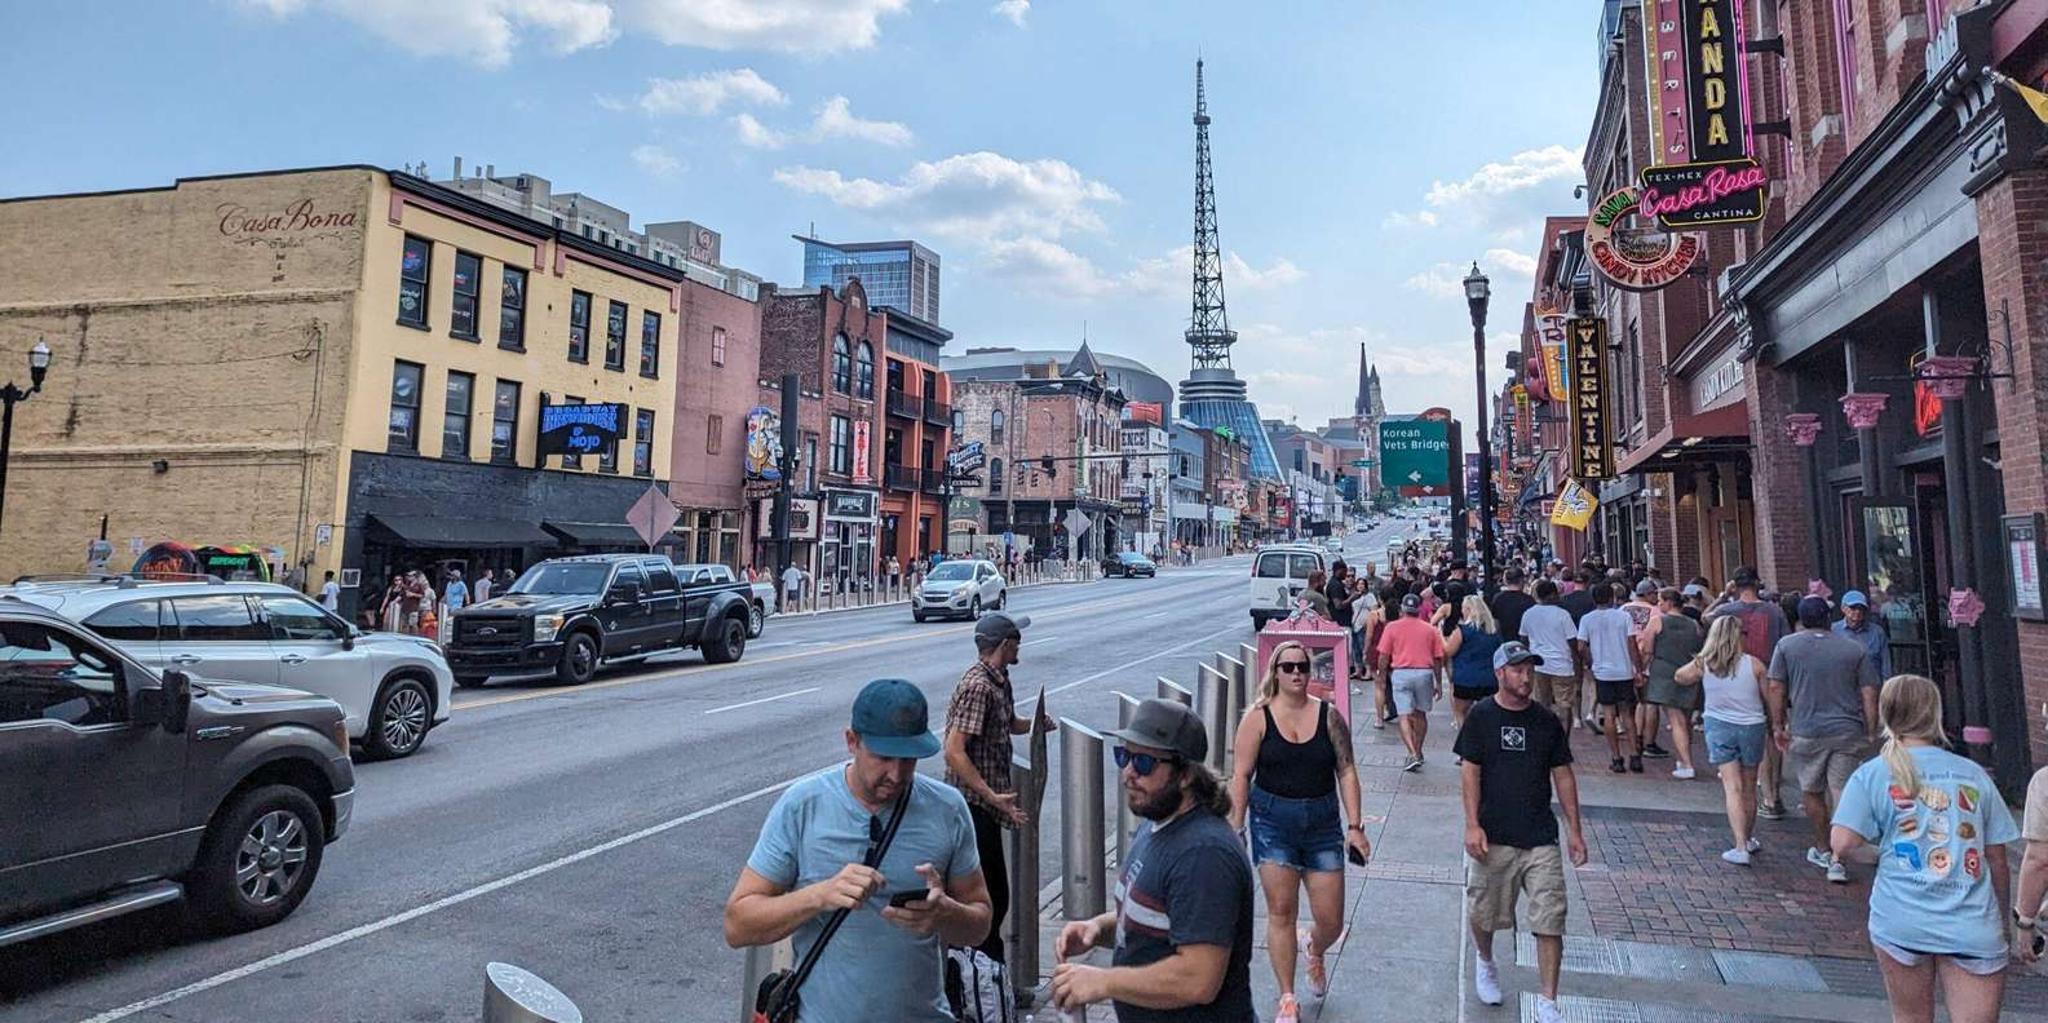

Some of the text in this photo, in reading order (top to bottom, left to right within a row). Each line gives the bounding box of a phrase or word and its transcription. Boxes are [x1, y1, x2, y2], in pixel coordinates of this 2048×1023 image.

[1660, 0, 1685, 153] BERT'S
[1701, 0, 1729, 146] ANDA
[1649, 172, 1702, 182] TEX-MEX
[1639, 165, 1766, 218] Casa Rosa
[216, 198, 357, 236] Casa Bona
[1694, 208, 1754, 219] CANTINA
[1577, 328, 1601, 477] VALENTINE
[568, 436, 601, 452] MOJO
[1383, 429, 1420, 438] Korean
[1384, 441, 1407, 450] Vets
